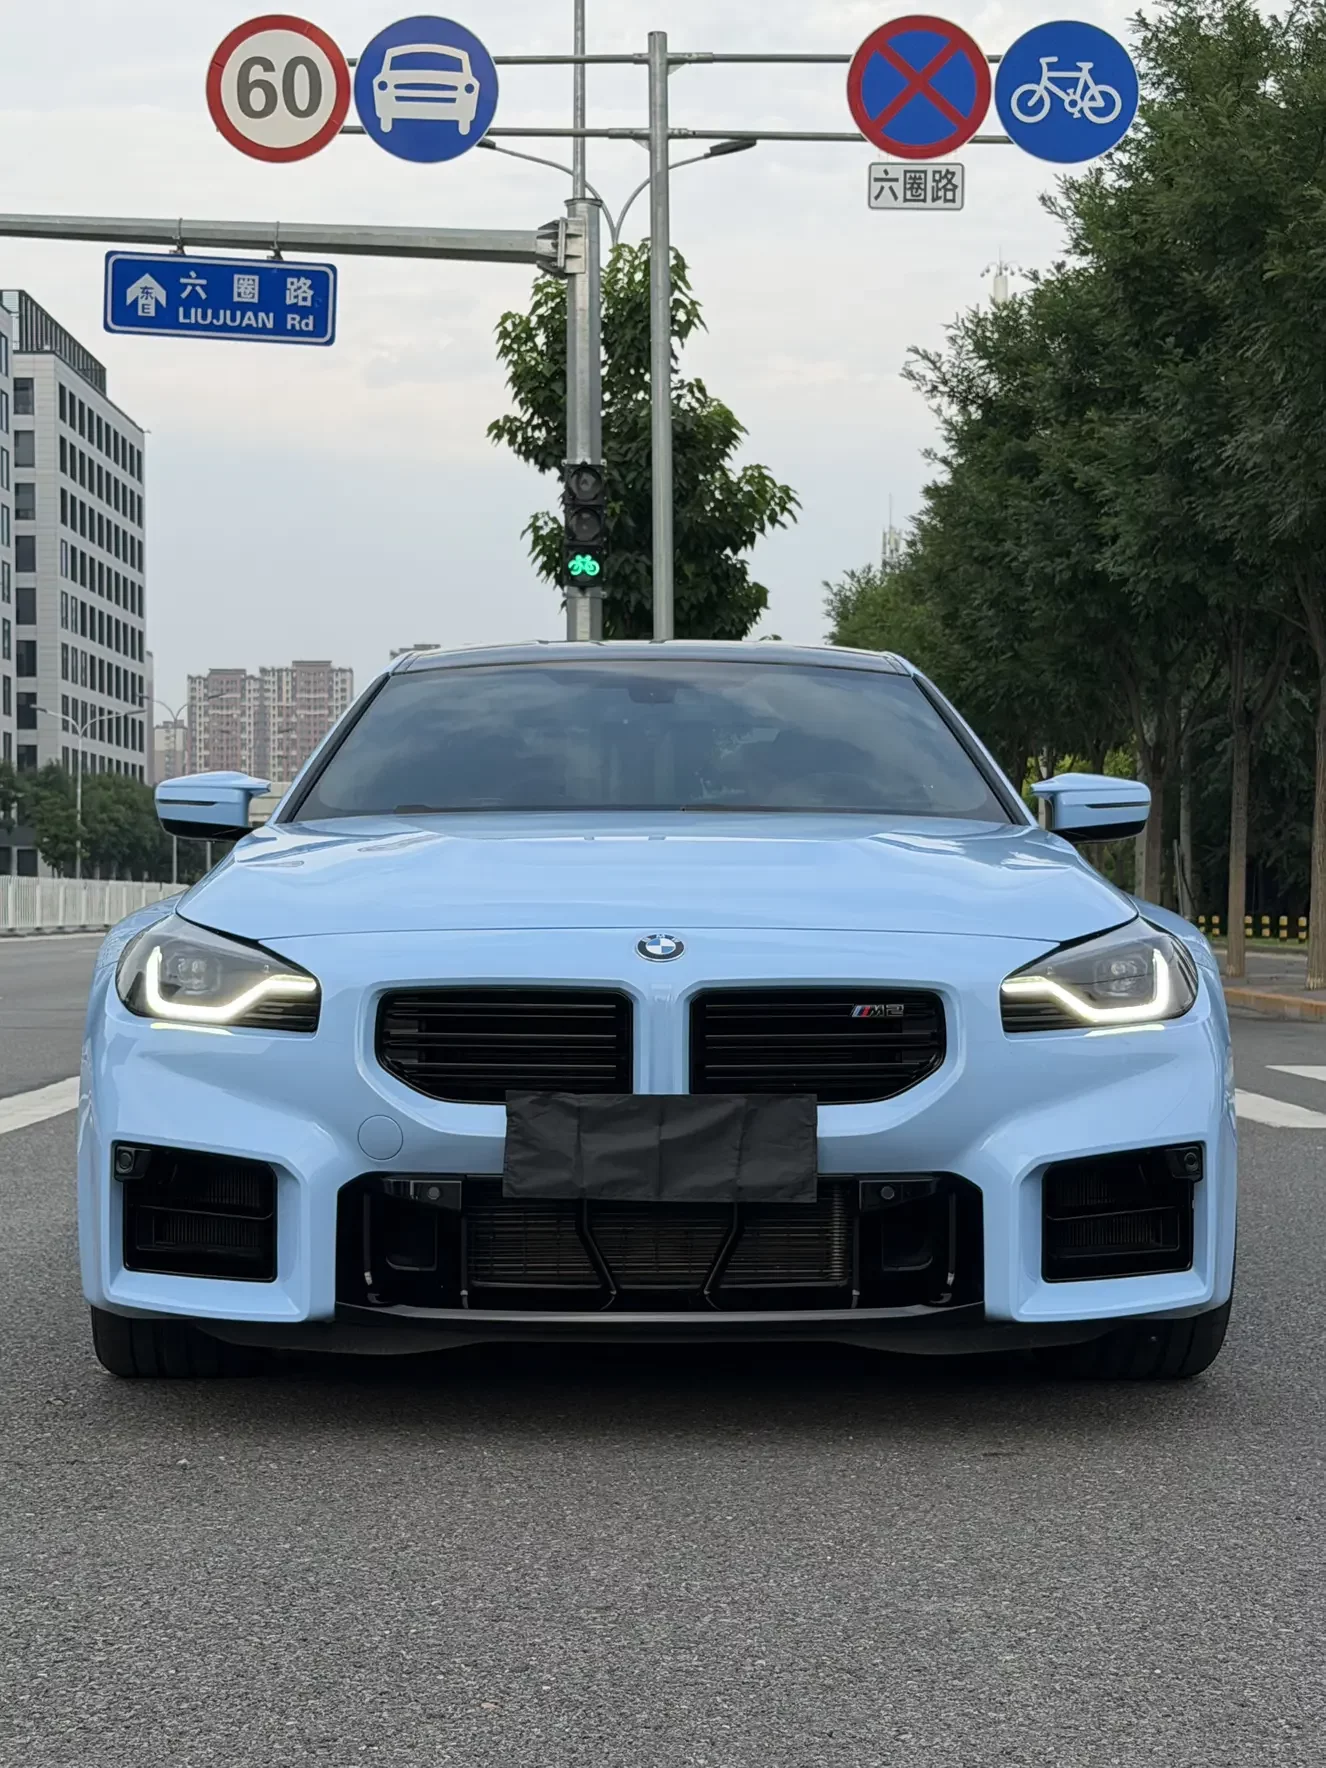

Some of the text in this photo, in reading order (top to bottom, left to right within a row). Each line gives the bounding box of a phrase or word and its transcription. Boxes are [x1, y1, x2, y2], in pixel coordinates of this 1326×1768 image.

[236, 55, 322, 119] 60
[873, 168, 958, 203] 六圈路
[140, 285, 154, 300] 东
[180, 271, 314, 307] 六圈路
[141, 303, 151, 315] E
[178, 306, 314, 331] LIUJUAN Rd
[867, 1004, 904, 1017] M2
